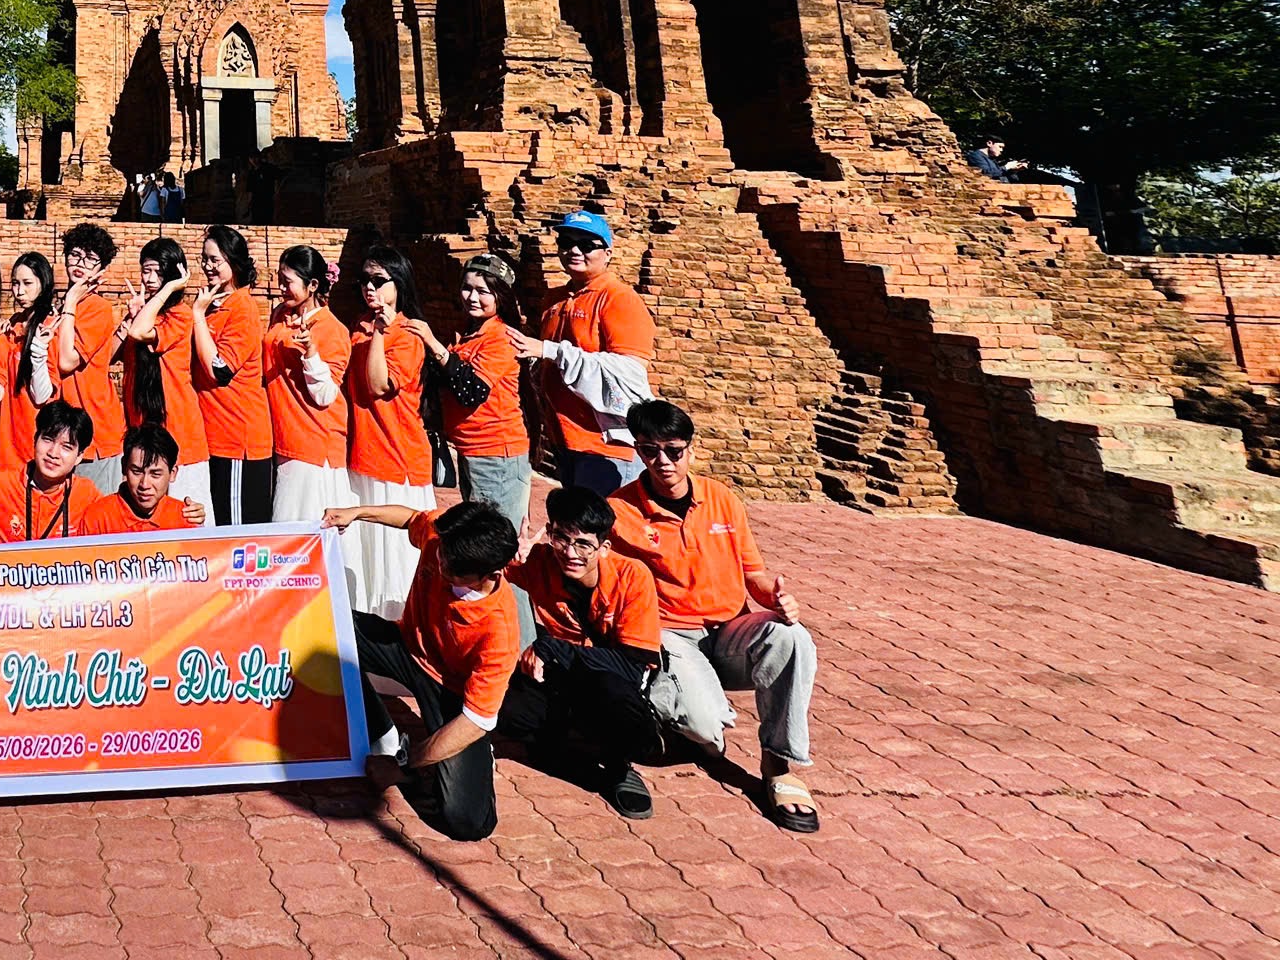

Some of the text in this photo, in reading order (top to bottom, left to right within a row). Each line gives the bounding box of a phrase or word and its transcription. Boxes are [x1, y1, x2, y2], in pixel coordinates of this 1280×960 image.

[94, 560, 118, 584] Cơ
[120, 555, 142, 584] Sở
[144, 552, 177, 583] Cần
[177, 555, 209, 582] Thơ
[232, 545, 309, 573] FPT Education
[224, 577, 320, 588] FPT POLYECHNIC
[37, 603, 54, 628] &
[60, 602, 86, 628] LH
[91, 600, 133, 627] 21.3
[3, 652, 83, 709] Ninh
[86, 651, 146, 704] Chữ
[177, 648, 231, 701] Đà
[237, 647, 291, 707] Lạt
[102, 730, 200, 754] 29/06/2026
